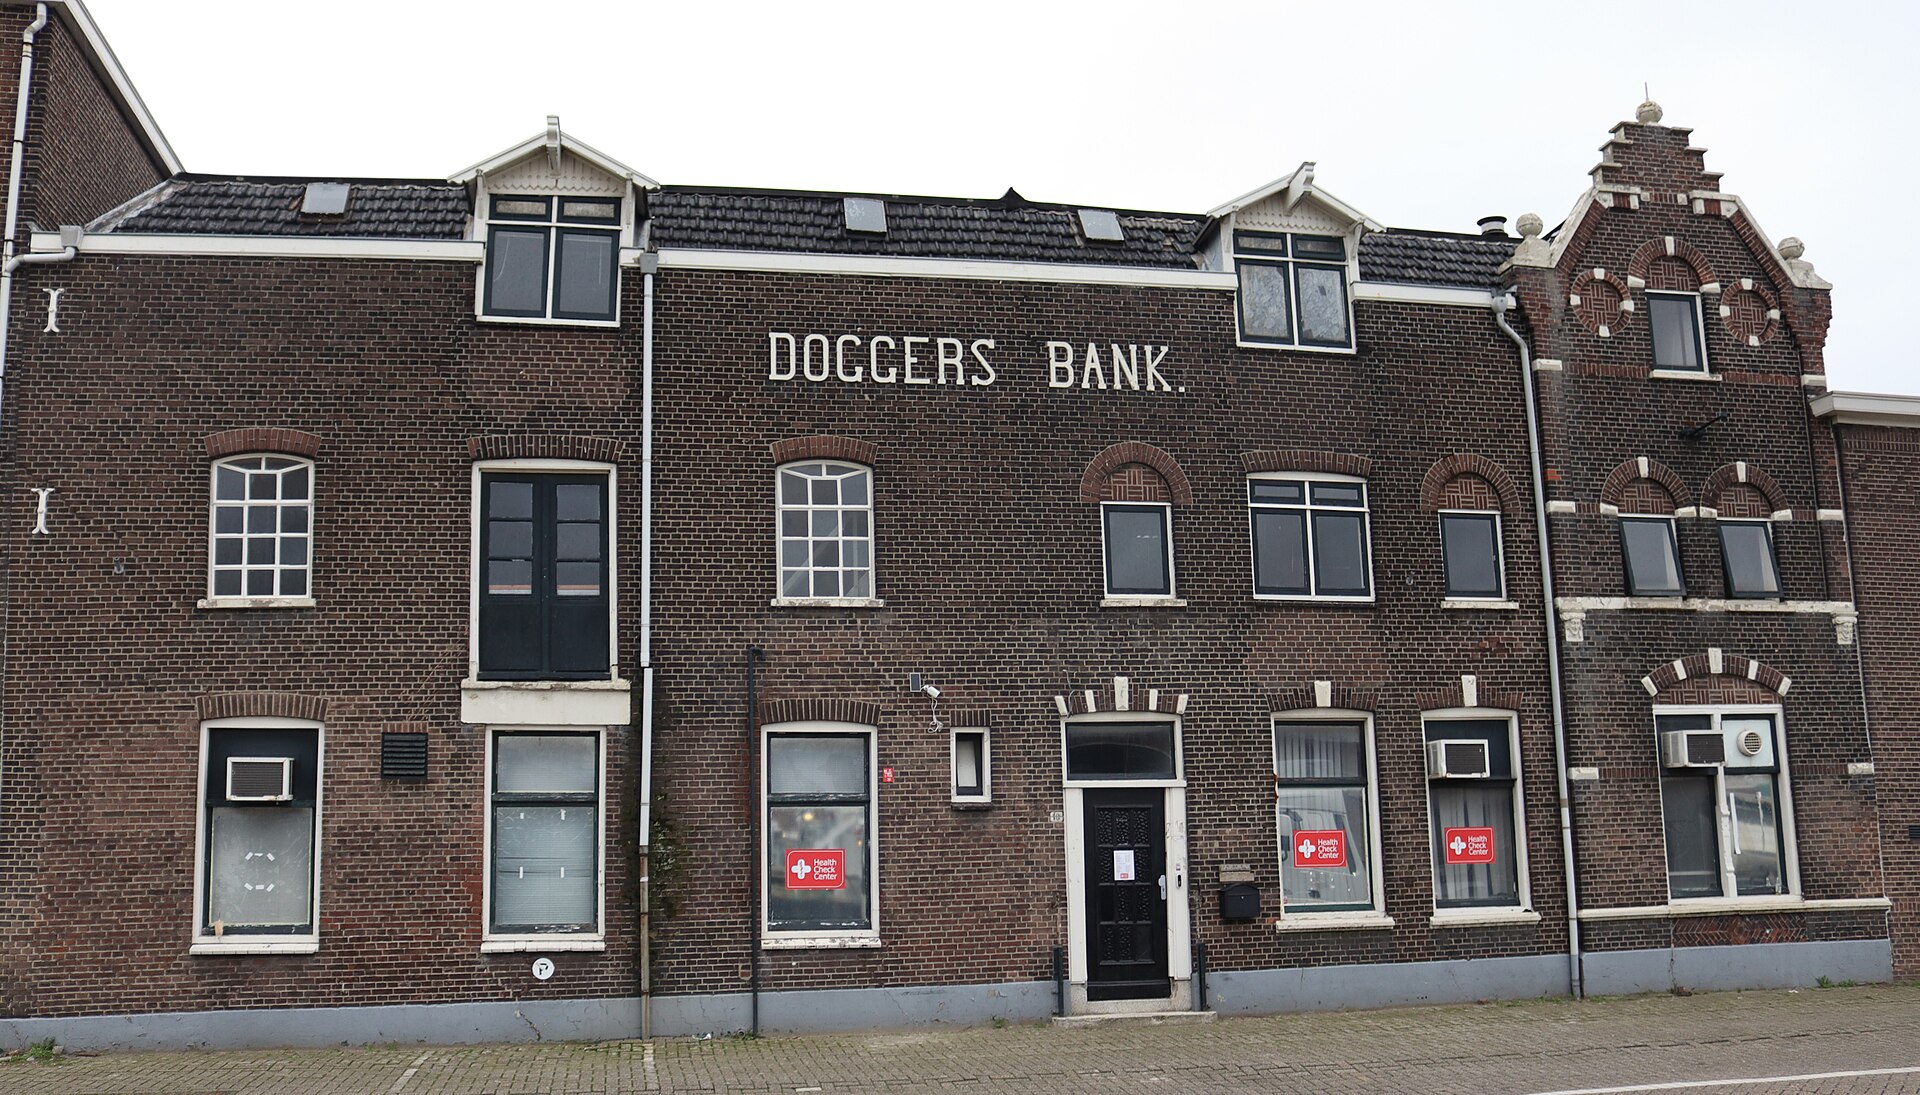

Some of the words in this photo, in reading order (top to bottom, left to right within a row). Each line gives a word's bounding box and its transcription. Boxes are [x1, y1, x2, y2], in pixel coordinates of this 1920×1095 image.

[768, 332, 996, 386] DOGGERS
[1047, 341, 1185, 392] BANK.
[1317, 838, 1339, 846] Health
[1467, 835, 1488, 843] Health
[813, 858, 837, 866] Health
